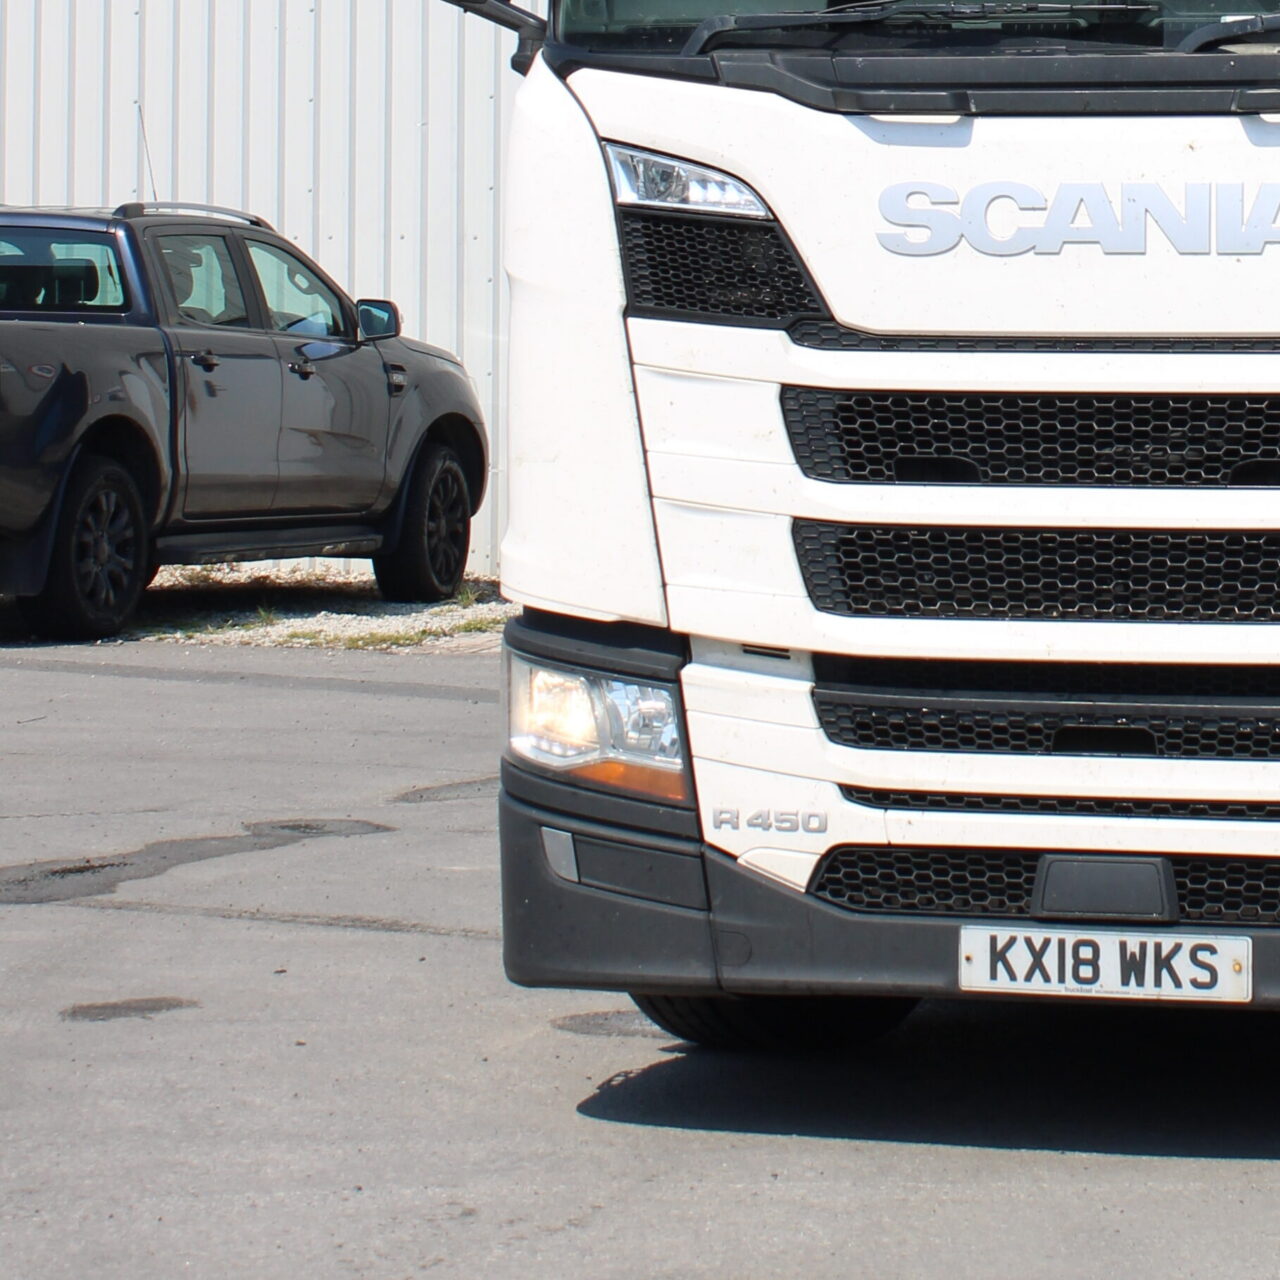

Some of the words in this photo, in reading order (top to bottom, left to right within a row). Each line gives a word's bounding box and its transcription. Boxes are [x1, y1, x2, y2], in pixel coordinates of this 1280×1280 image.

[712, 808, 740, 831] R
[746, 808, 828, 834] 450
[989, 934, 1101, 986] KX18
[1119, 939, 1219, 991] WKS
